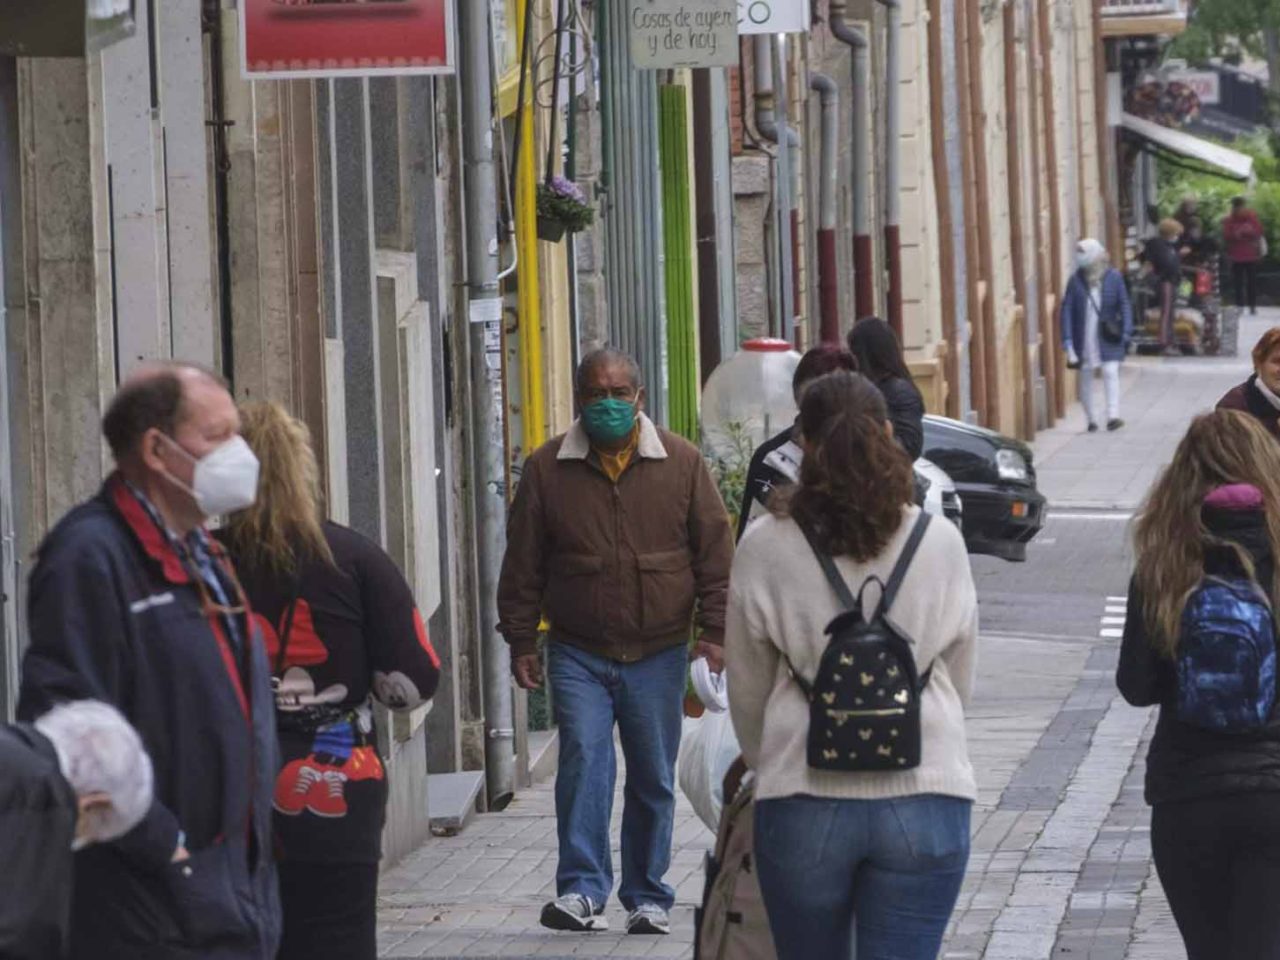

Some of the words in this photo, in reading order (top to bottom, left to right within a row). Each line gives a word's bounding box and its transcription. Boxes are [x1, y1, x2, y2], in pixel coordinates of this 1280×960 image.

[632, 7, 672, 29] Cosas
[674, 7, 691, 28] de
[695, 10, 734, 31] ayer
[649, 34, 658, 57] y
[663, 28, 682, 50] de
[688, 30, 717, 56] hoy
